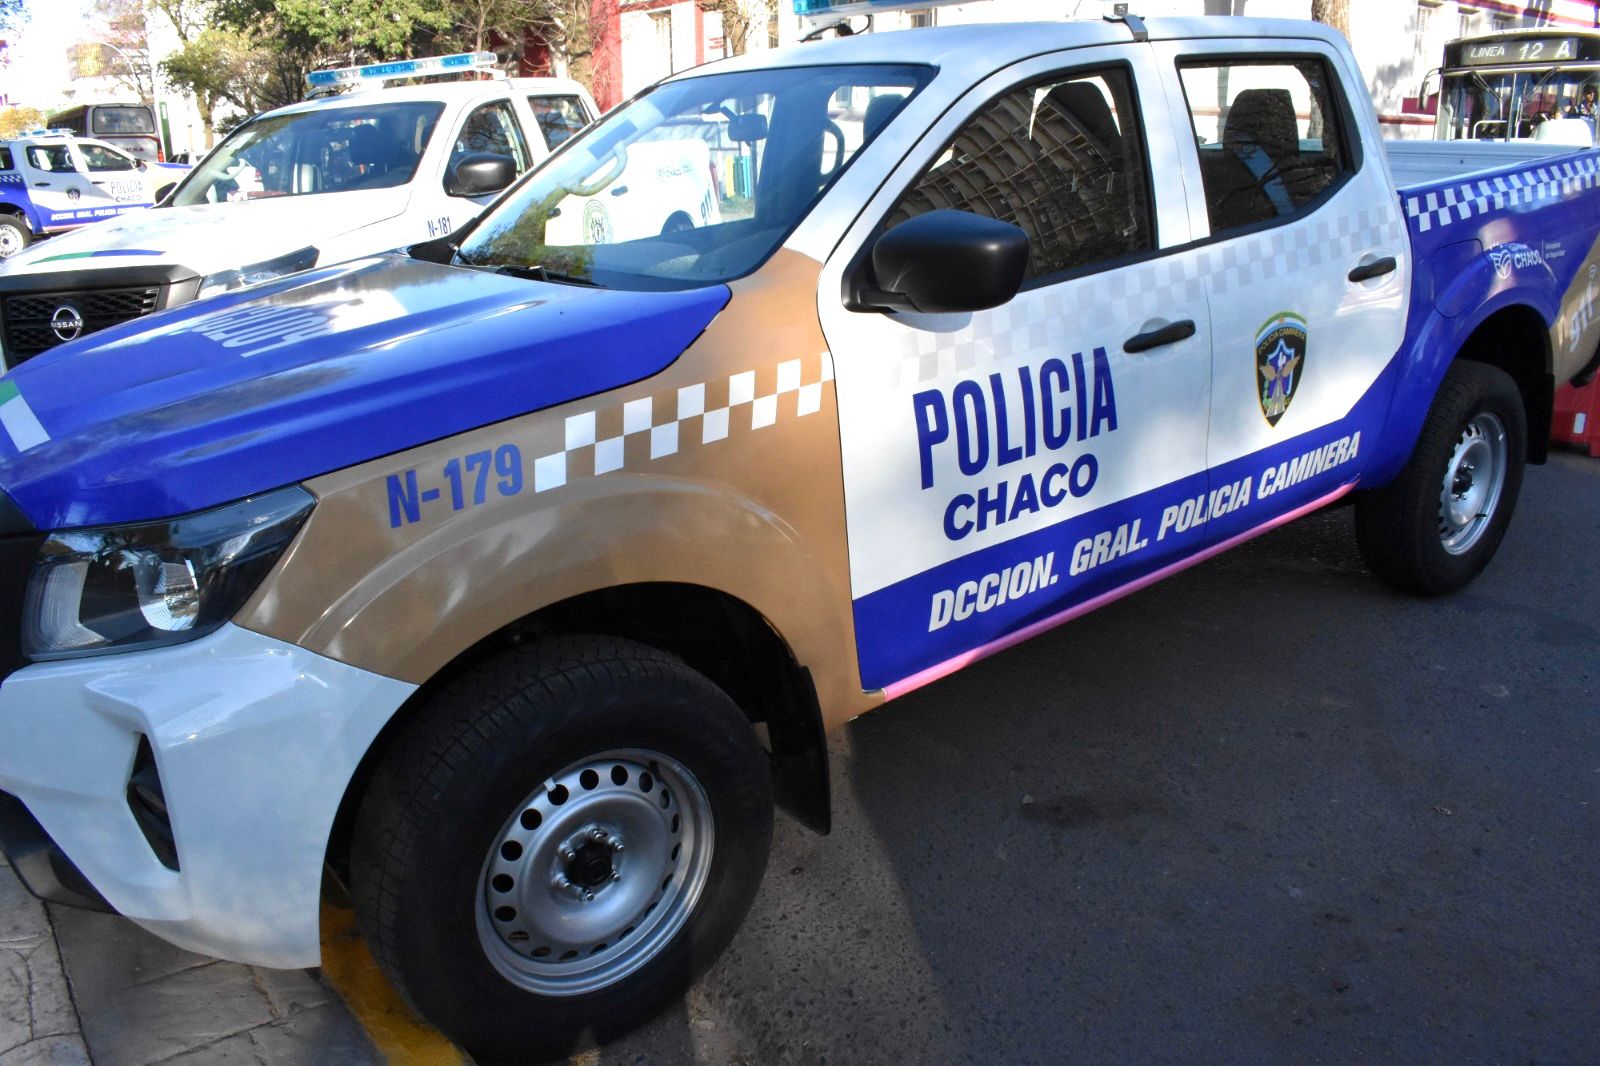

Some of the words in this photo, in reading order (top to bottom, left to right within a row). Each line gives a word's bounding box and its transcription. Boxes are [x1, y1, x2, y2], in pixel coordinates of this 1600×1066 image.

[1469, 46, 1505, 58] LINEA
[1519, 42, 1544, 61] 12
[1554, 40, 1570, 58] A
[110, 181, 143, 195] POLICIA
[115, 195, 142, 203] CHACO
[427, 215, 452, 238] N-181
[1514, 250, 1542, 269] CHACO
[51, 320, 83, 329] NISSAN
[913, 347, 1118, 490] POLICIA
[386, 443, 524, 529] N-179
[943, 453, 1099, 541] CHACO
[928, 562, 1058, 633] DCCION.
[1069, 519, 1148, 576] GRAL.
[1157, 475, 1252, 541] POLICIA
[1257, 431, 1362, 499] CAMINERA
